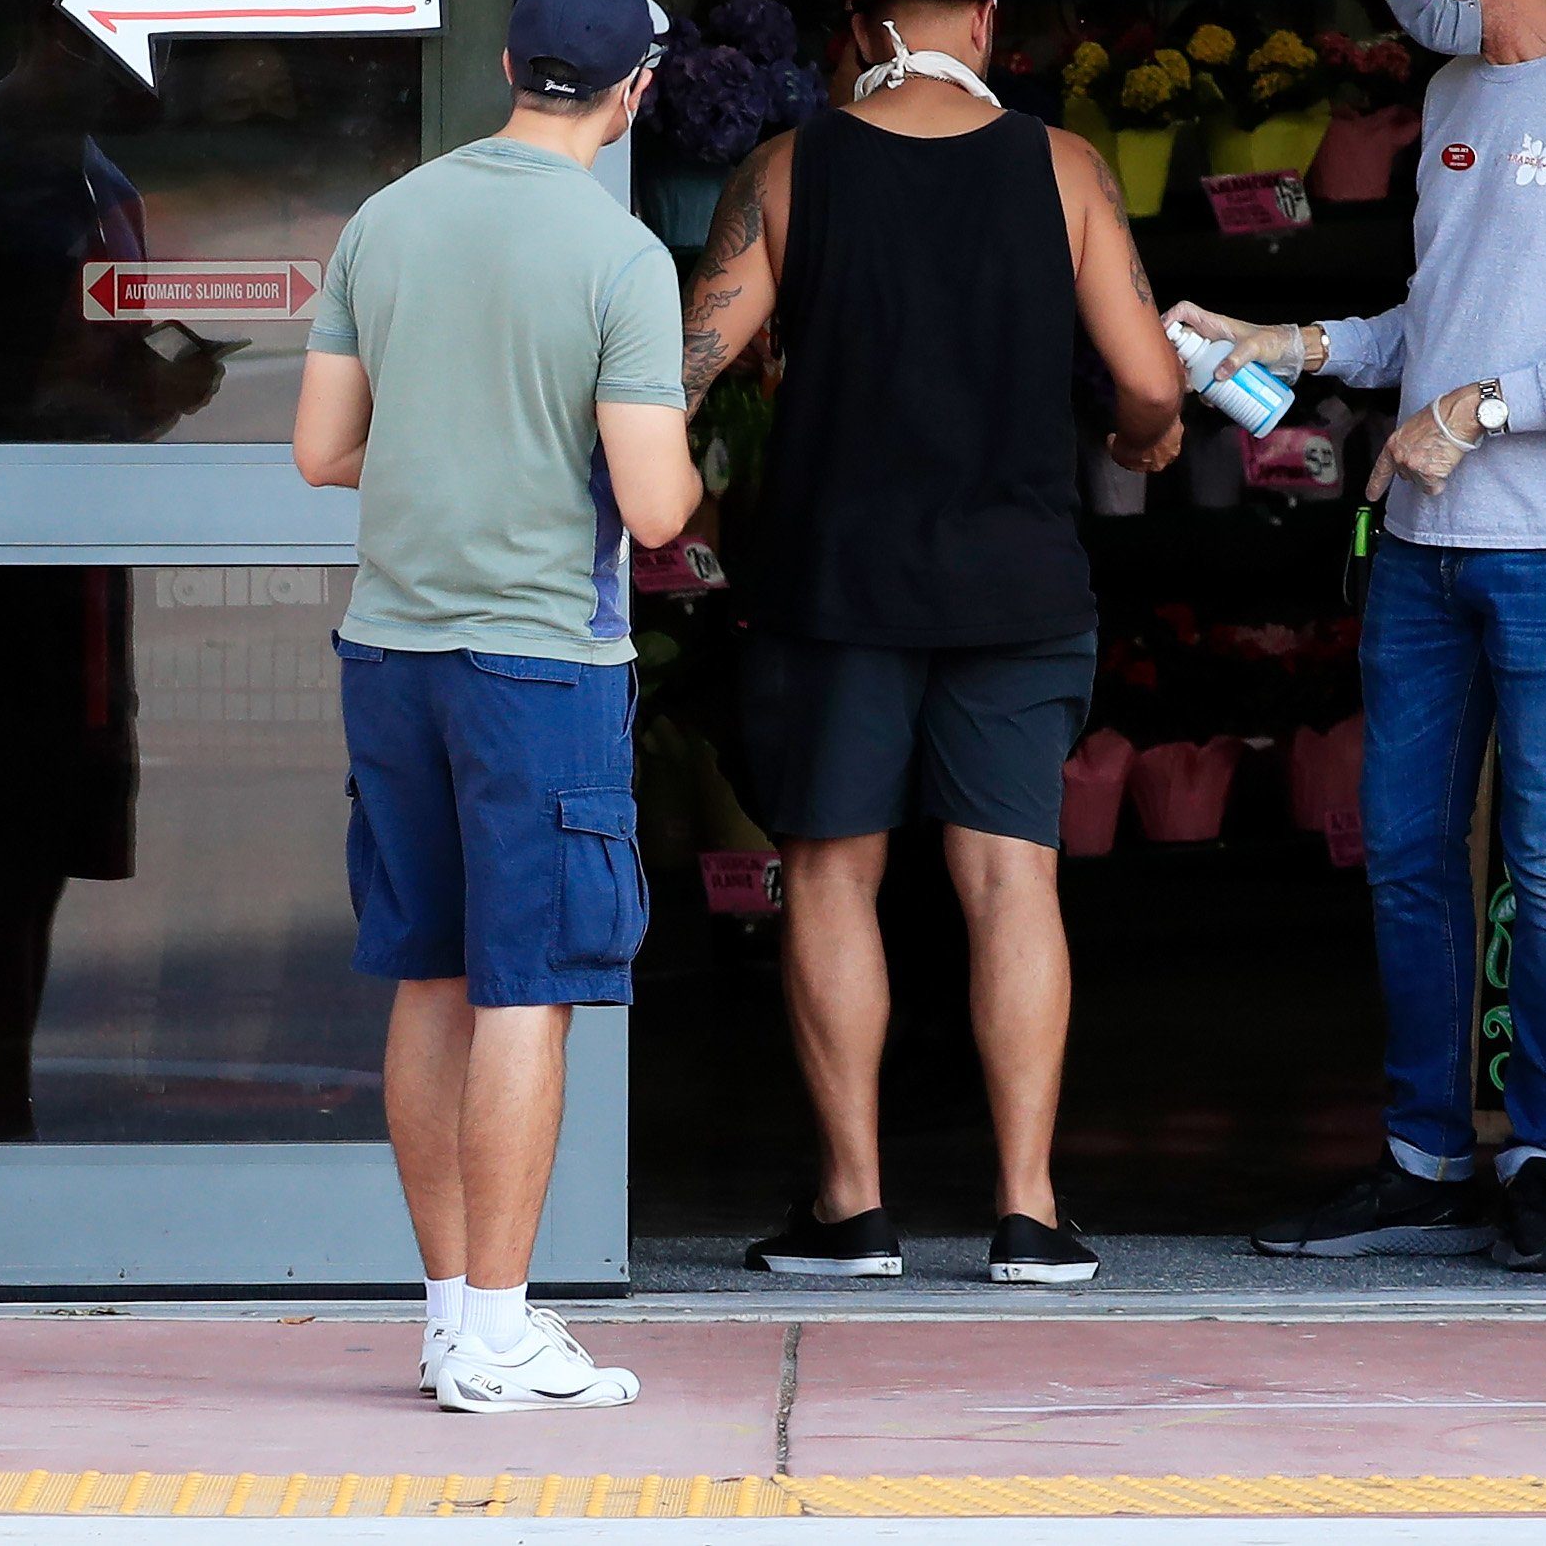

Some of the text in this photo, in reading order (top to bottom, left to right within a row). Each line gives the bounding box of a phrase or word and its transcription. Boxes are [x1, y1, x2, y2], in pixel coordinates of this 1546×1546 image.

[125, 283, 280, 301] AUTOMATIC SLIDING DOOR
[469, 1373, 503, 1395] FILA
